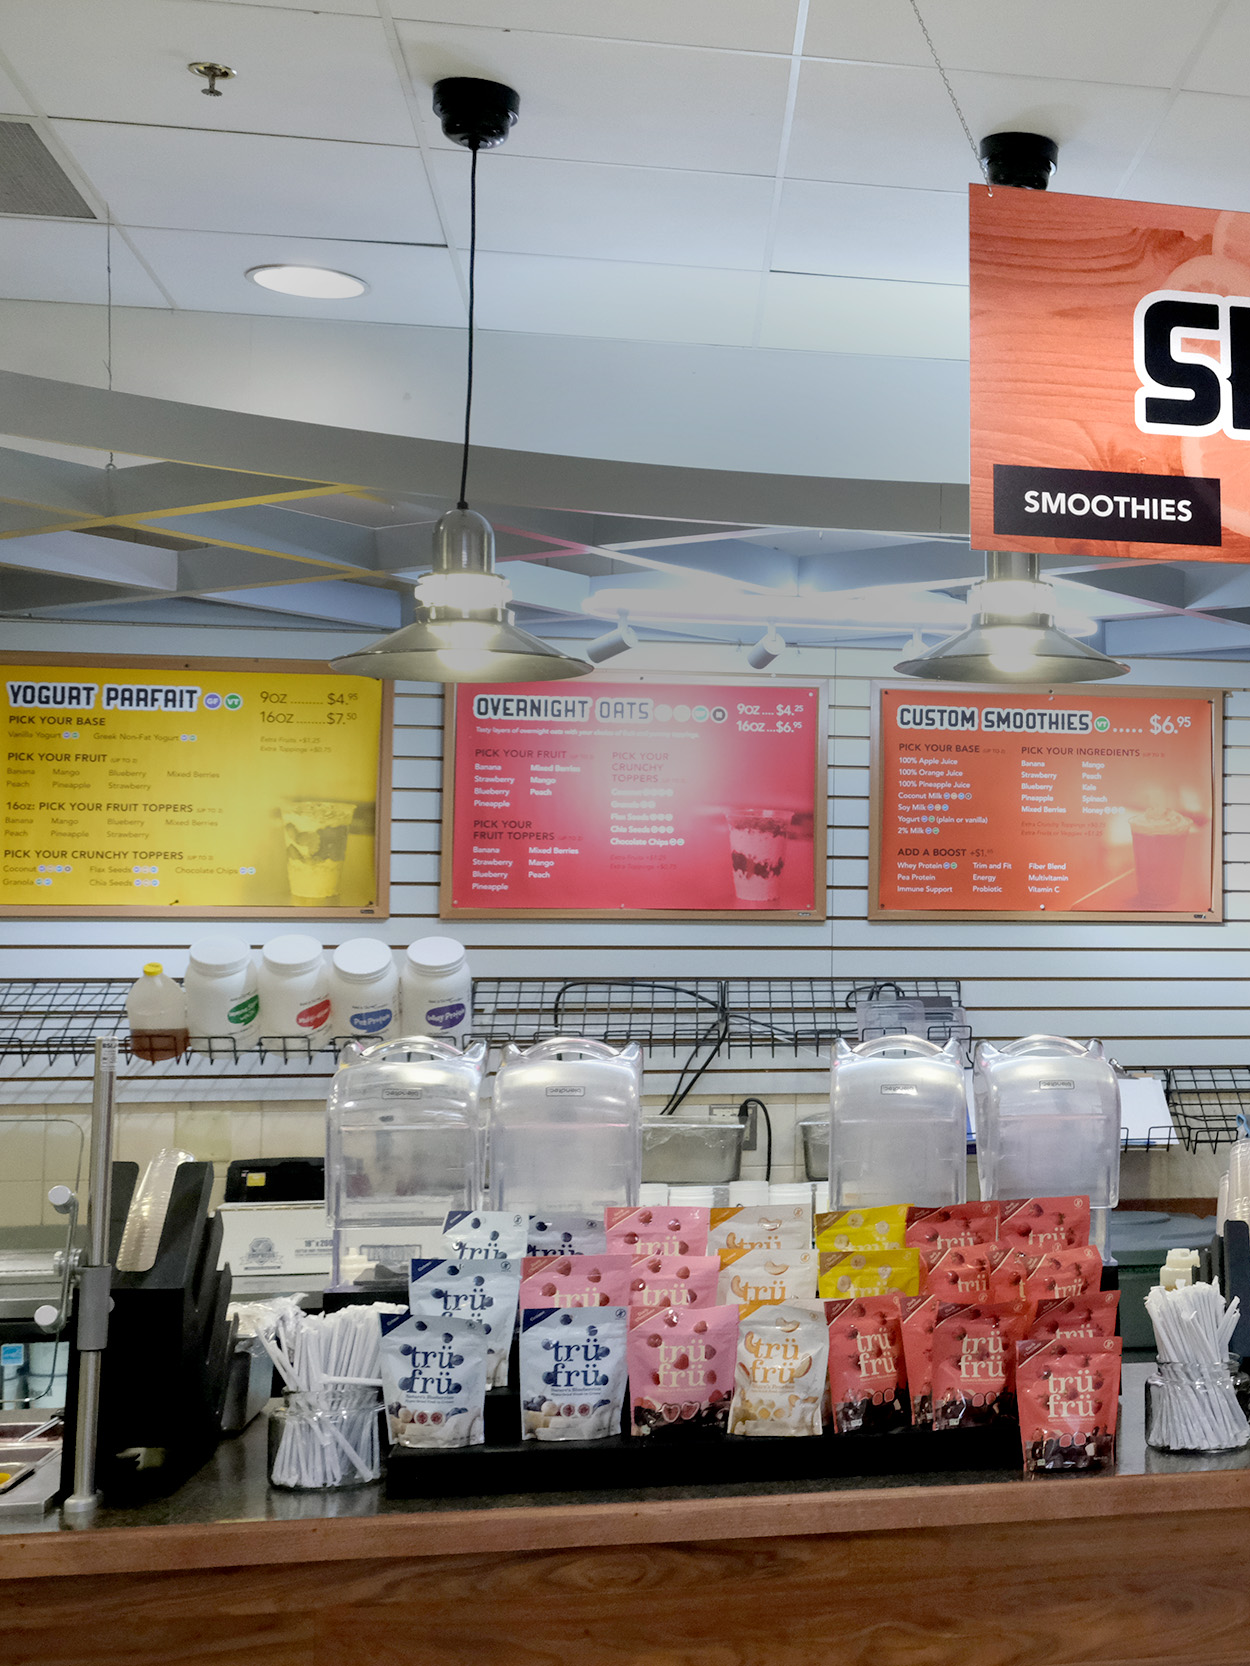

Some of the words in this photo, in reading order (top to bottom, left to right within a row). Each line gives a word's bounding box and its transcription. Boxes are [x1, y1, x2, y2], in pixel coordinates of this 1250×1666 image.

[1023, 489, 1193, 524] SMOOTHIES
[9, 684, 95, 706] YOGURT
[106, 687, 198, 708] PARFAIT
[476, 698, 588, 718] OVERNIGHT
[600, 701, 650, 720] OATS
[776, 704, 804, 716] $4.25
[9, 716, 35, 724] PICK
[40, 716, 72, 726] YOUR
[76, 717, 106, 726] BASE
[900, 708, 975, 728] CUSTOM
[984, 710, 1090, 730] SMOOTHIES
[1150, 714, 1192, 735] $6.95
[776, 720, 802, 733] $6.95
[899, 744, 922, 752] PICK
[924, 744, 952, 752] YOUR
[956, 745, 980, 753] BASE
[1021, 746, 1044, 754] PICK
[1046, 747, 1074, 756] YOUR
[1076, 748, 1140, 757] INGREDIENTS
[8, 753, 34, 761] PICK
[38, 754, 70, 762] YOUR
[75, 754, 107, 762] FRUIT
[475, 750, 500, 758] PICK
[502, 750, 534, 758] YOUR
[537, 750, 567, 758] FRUIT
[612, 752, 636, 760] PICK
[640, 752, 669, 760] YOUR
[919, 758, 939, 766] Apple
[612, 763, 664, 772] CRUNCHY
[918, 769, 944, 777] Orange
[1021, 772, 1058, 780] Strawberry
[612, 774, 658, 783] TOPPERS
[918, 781, 952, 790] Pineapple
[1021, 783, 1054, 792] Blueberry
[1022, 794, 1054, 802] Pineapple
[39, 802, 65, 811] PICK
[70, 803, 102, 811] YOUR
[106, 804, 138, 812] FRUIT
[142, 804, 193, 812] TOPPERS
[898, 804, 911, 812] Soy
[474, 820, 498, 828] PICK
[501, 821, 532, 829] YOUR
[898, 816, 920, 824] Yogurt
[936, 816, 954, 825] (plain
[965, 816, 988, 824] vanilla)
[473, 832, 504, 840] FRUIT
[507, 832, 555, 840] TOPPERS
[4, 850, 30, 858] PICK
[35, 850, 68, 859] YOUR
[72, 851, 129, 860] CRUNCHY
[133, 852, 184, 860] TOPPERS
[898, 848, 920, 856] ADD
[922, 848, 930, 856] A
[932, 848, 967, 857] BOOST
[897, 862, 917, 870] Whey
[1047, 862, 1067, 870] Blend
[972, 874, 996, 882] Energy
[472, 883, 509, 892] Pineapple
[925, 886, 953, 894] Support
